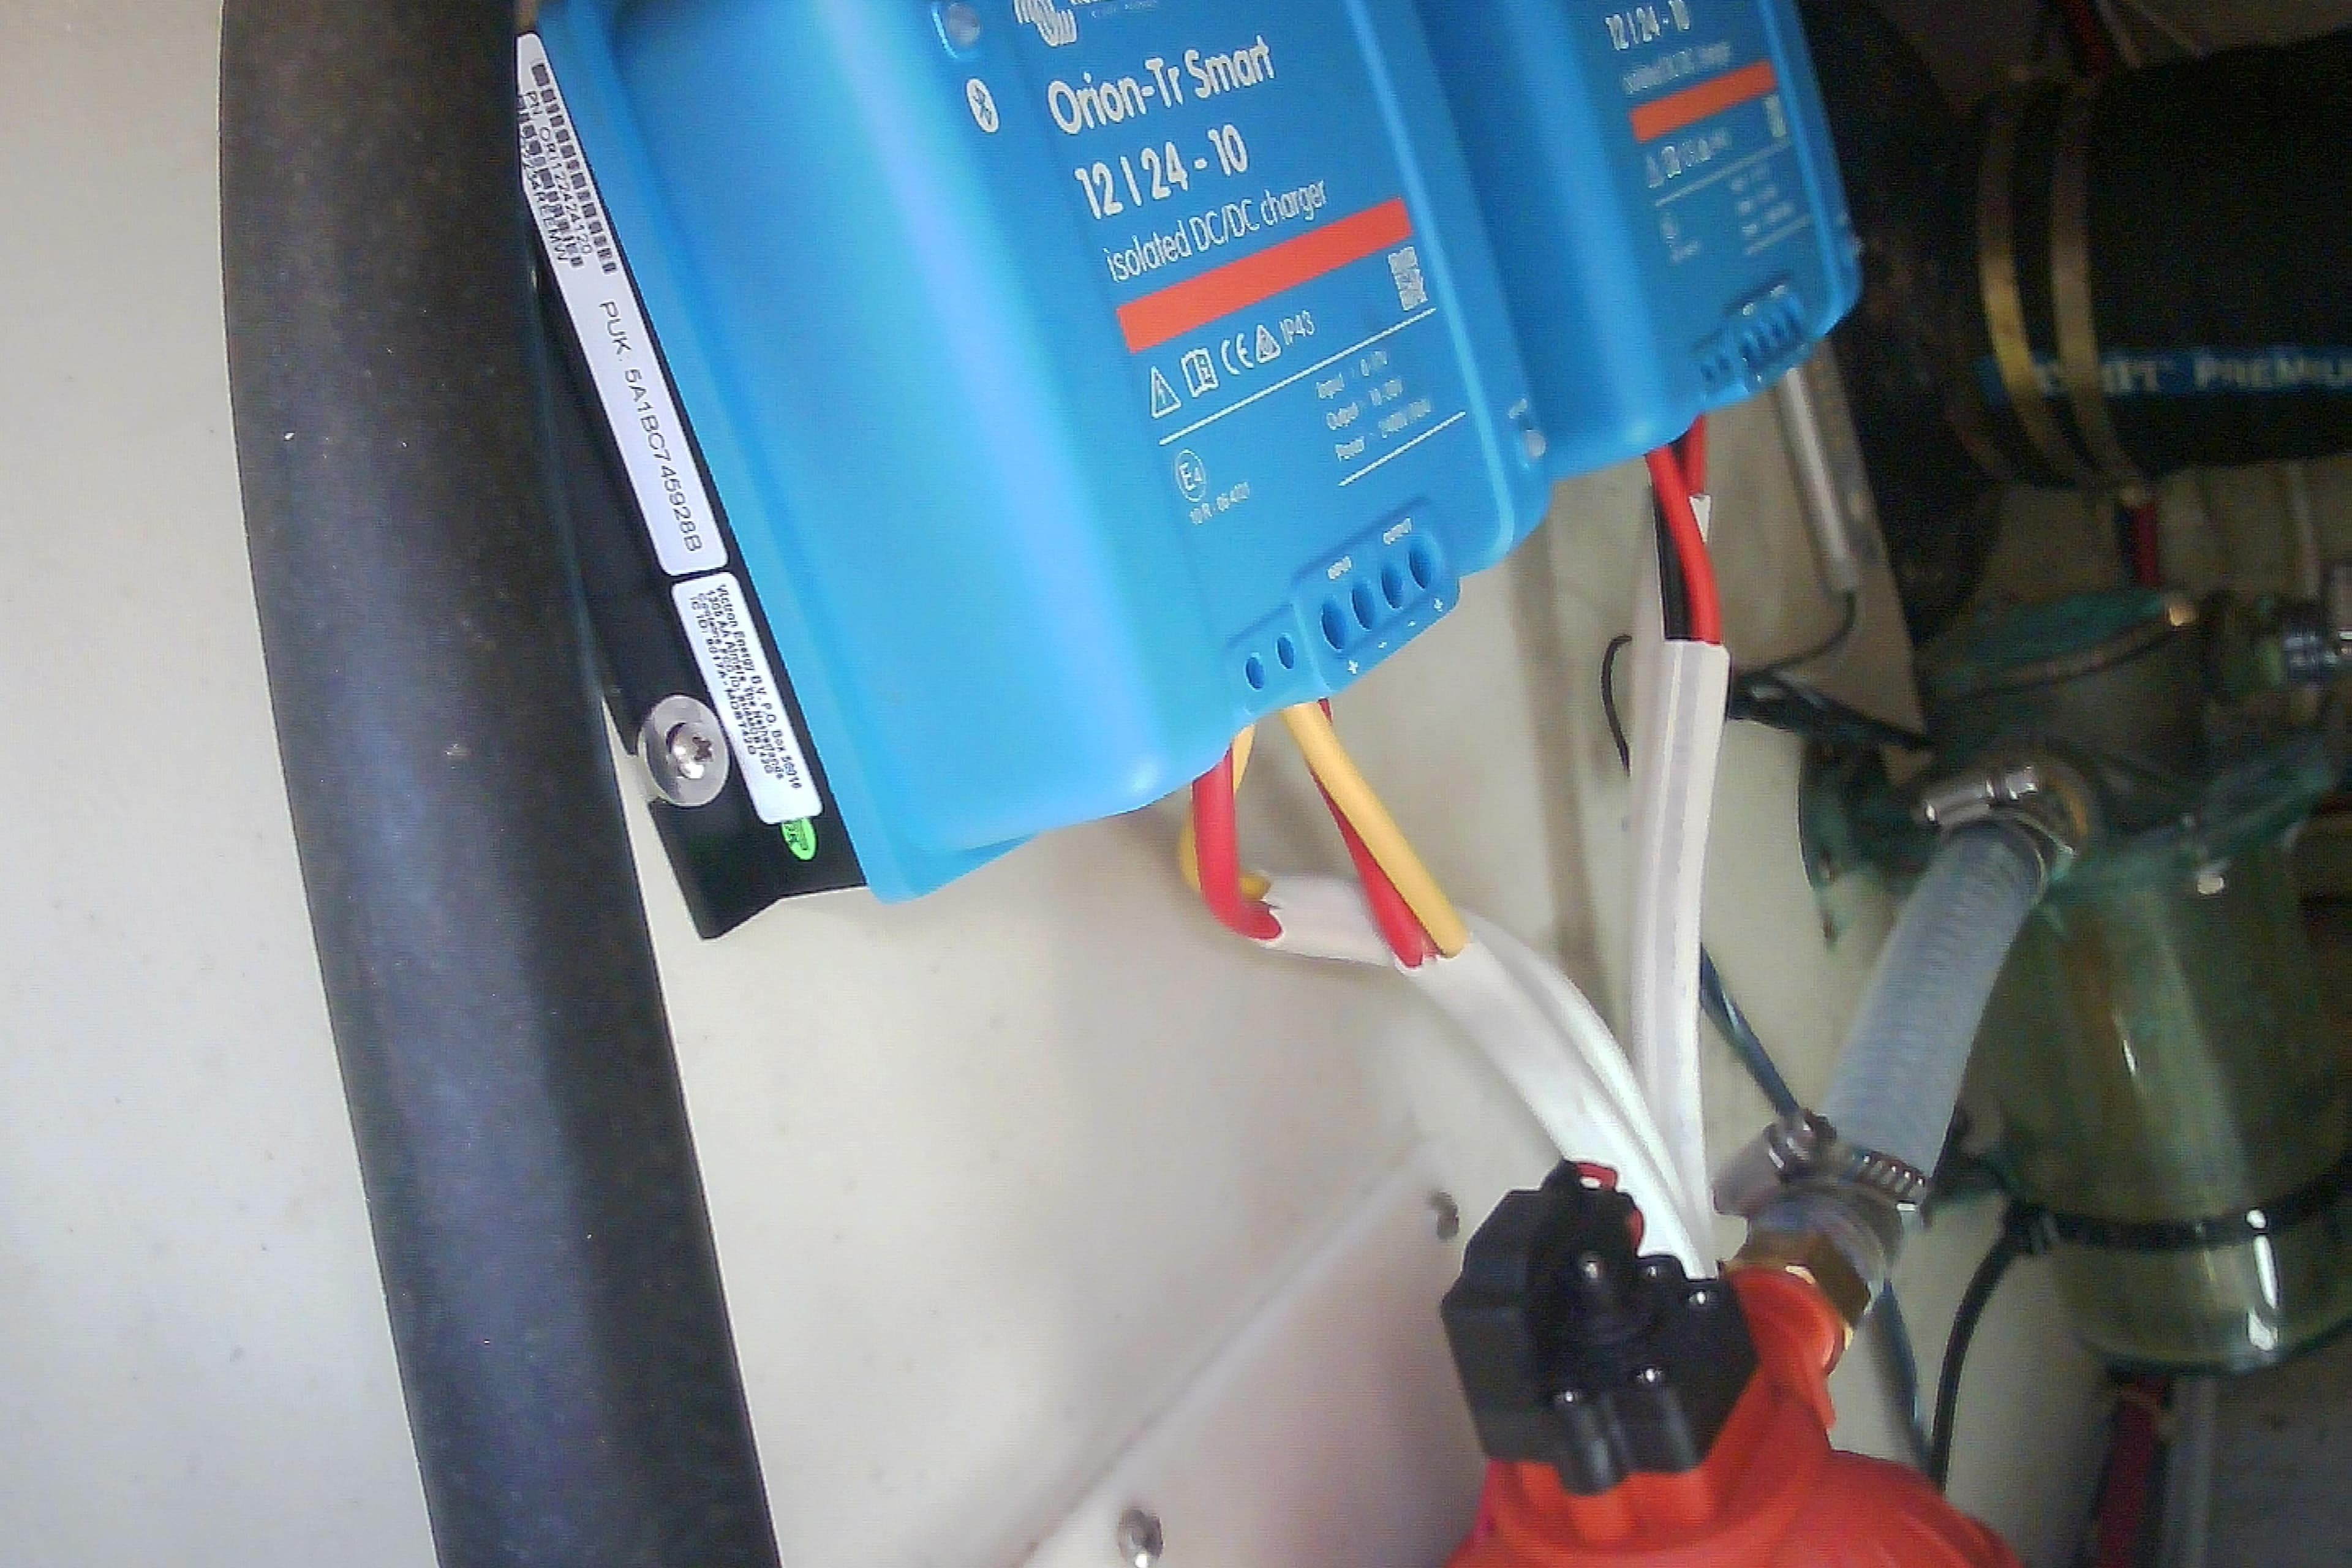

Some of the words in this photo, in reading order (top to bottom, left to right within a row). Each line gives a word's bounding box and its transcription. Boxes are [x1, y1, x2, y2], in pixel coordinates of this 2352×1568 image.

[1048, 58, 1183, 134] Orion-Tr
[1185, 35, 1275, 98] Smart
[1074, 162, 1125, 219] 12
[1140, 141, 1189, 200] 24
[1208, 124, 1248, 176] 10
[1103, 221, 1193, 283] isolated
[1188, 199, 1261, 252] DC/DC
[1260, 179, 1326, 226] charger
[1279, 310, 1315, 345] IP43
[733, 631, 754, 670] Energy
